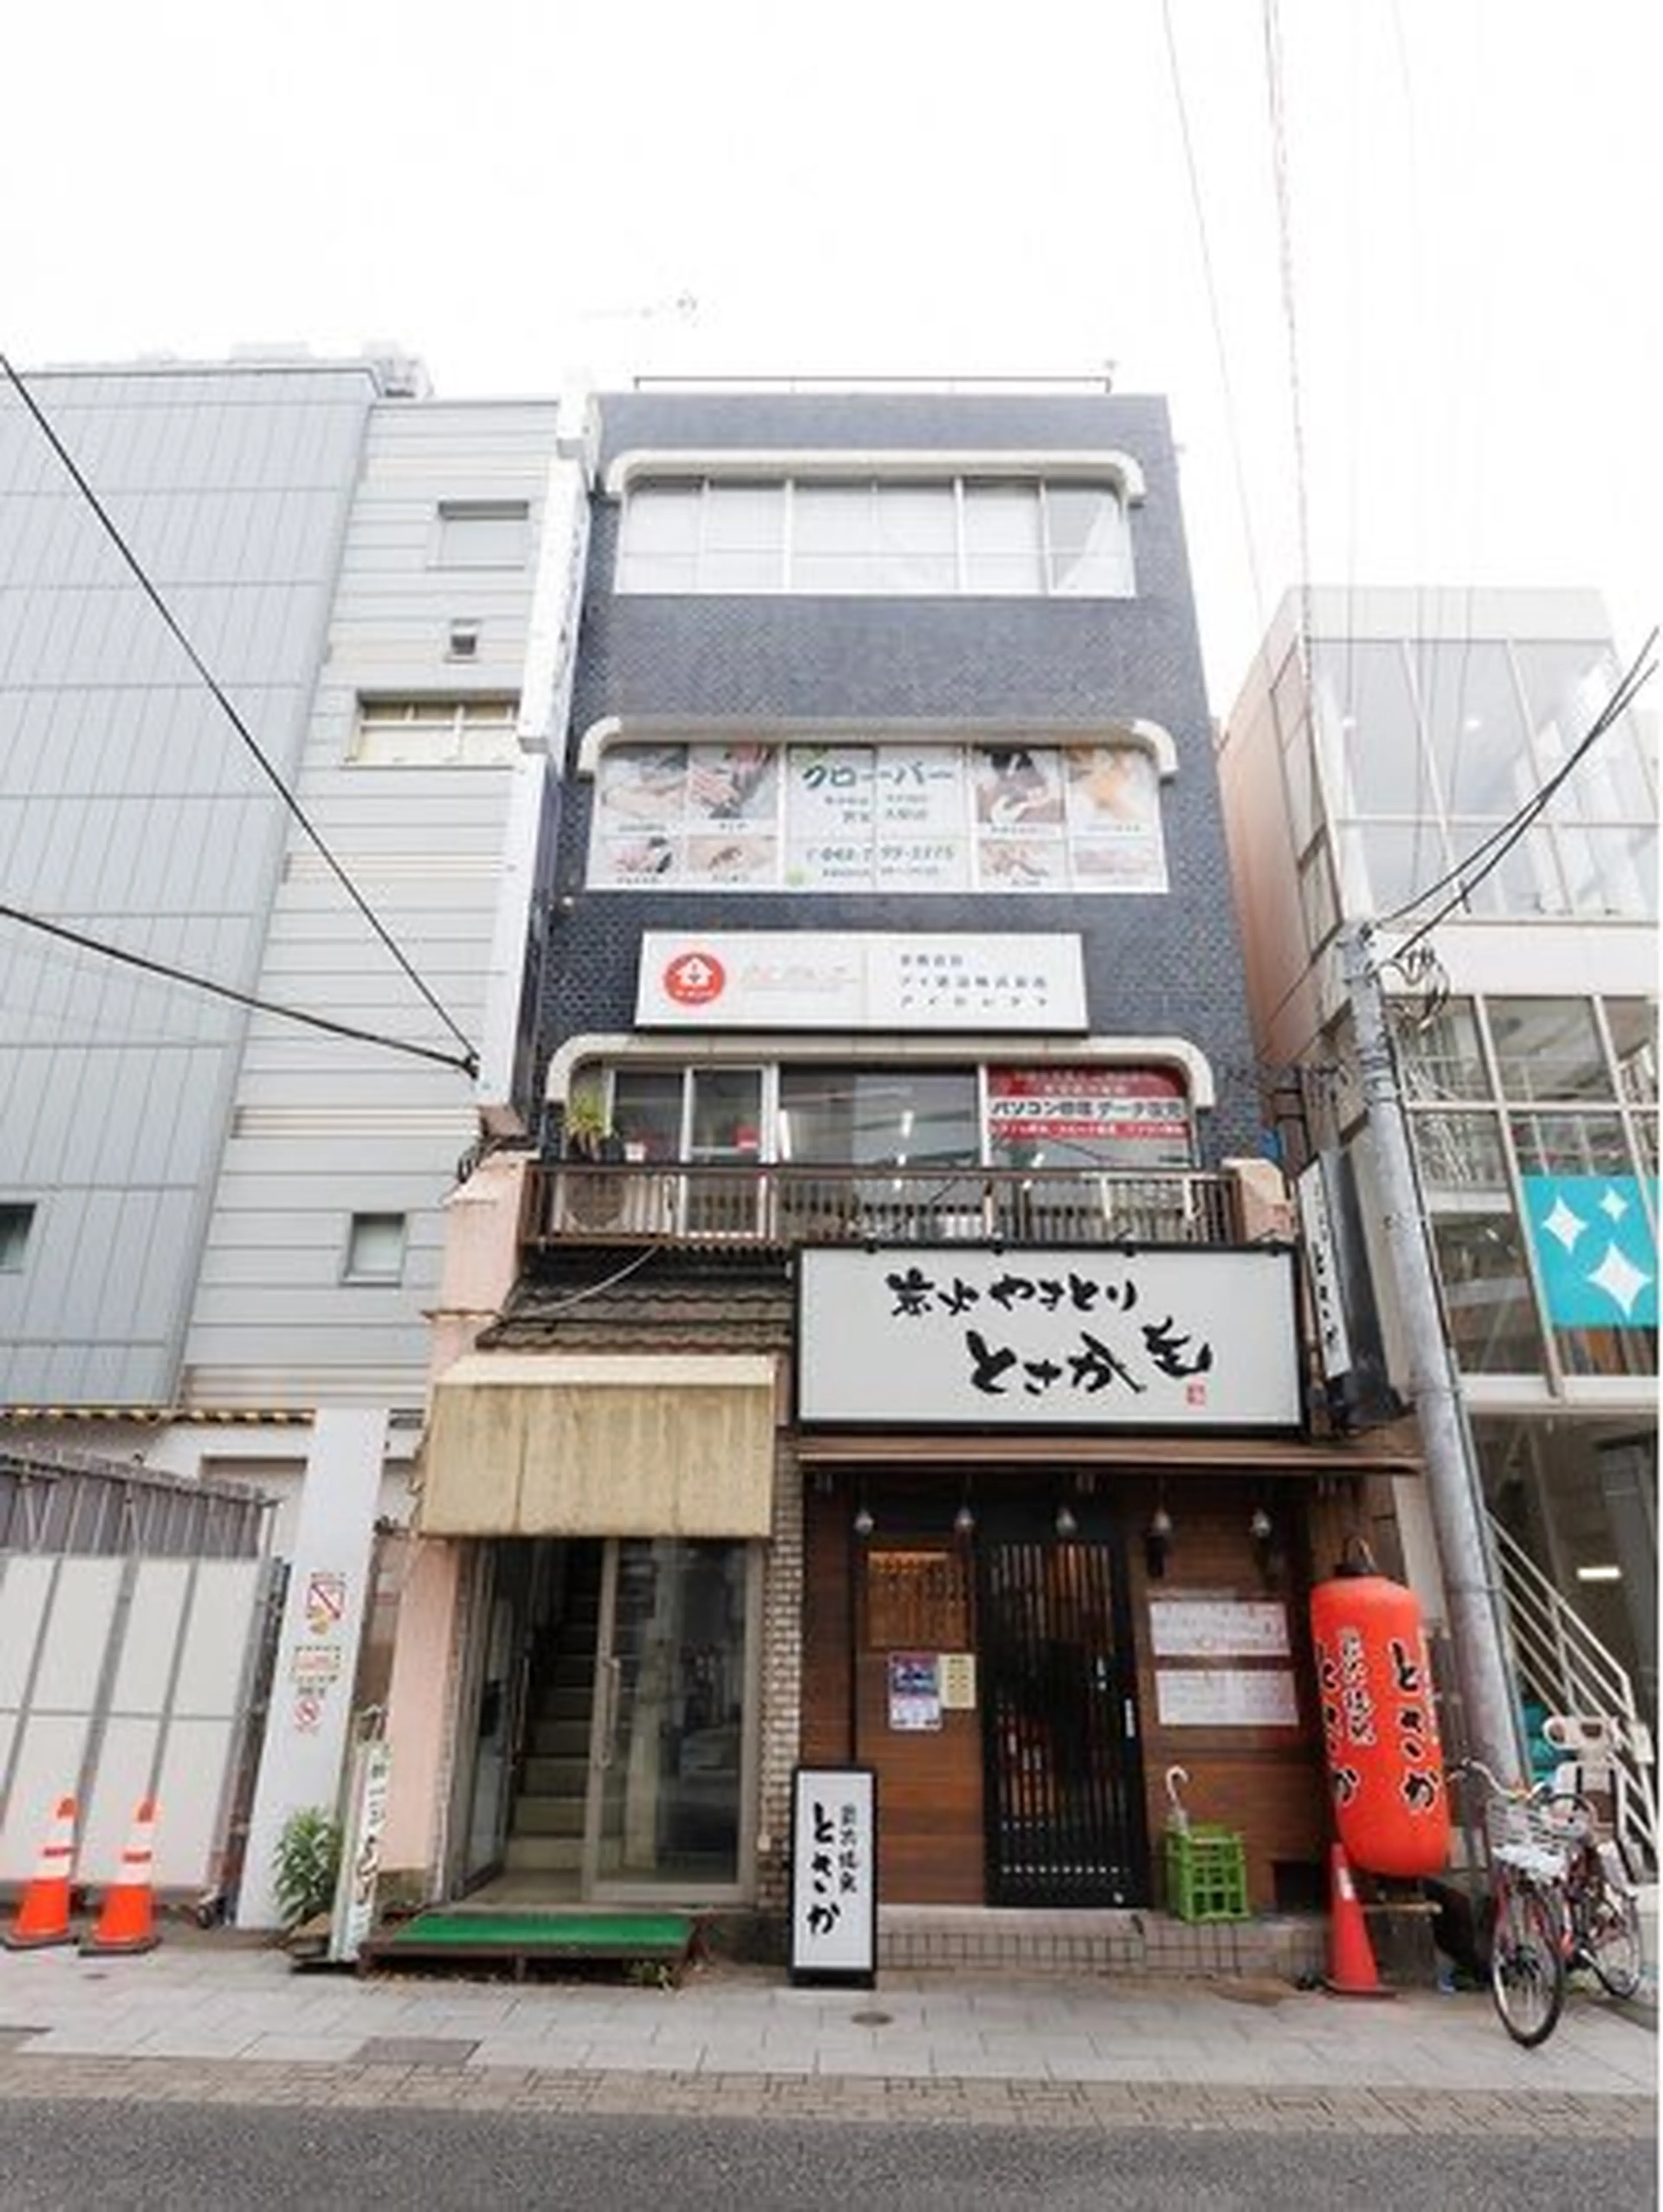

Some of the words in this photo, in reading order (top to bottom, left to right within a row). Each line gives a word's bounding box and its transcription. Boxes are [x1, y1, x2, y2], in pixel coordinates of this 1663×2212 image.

[1389, 1640, 1441, 1811] とさか
[807, 1802, 841, 1934] とさか
